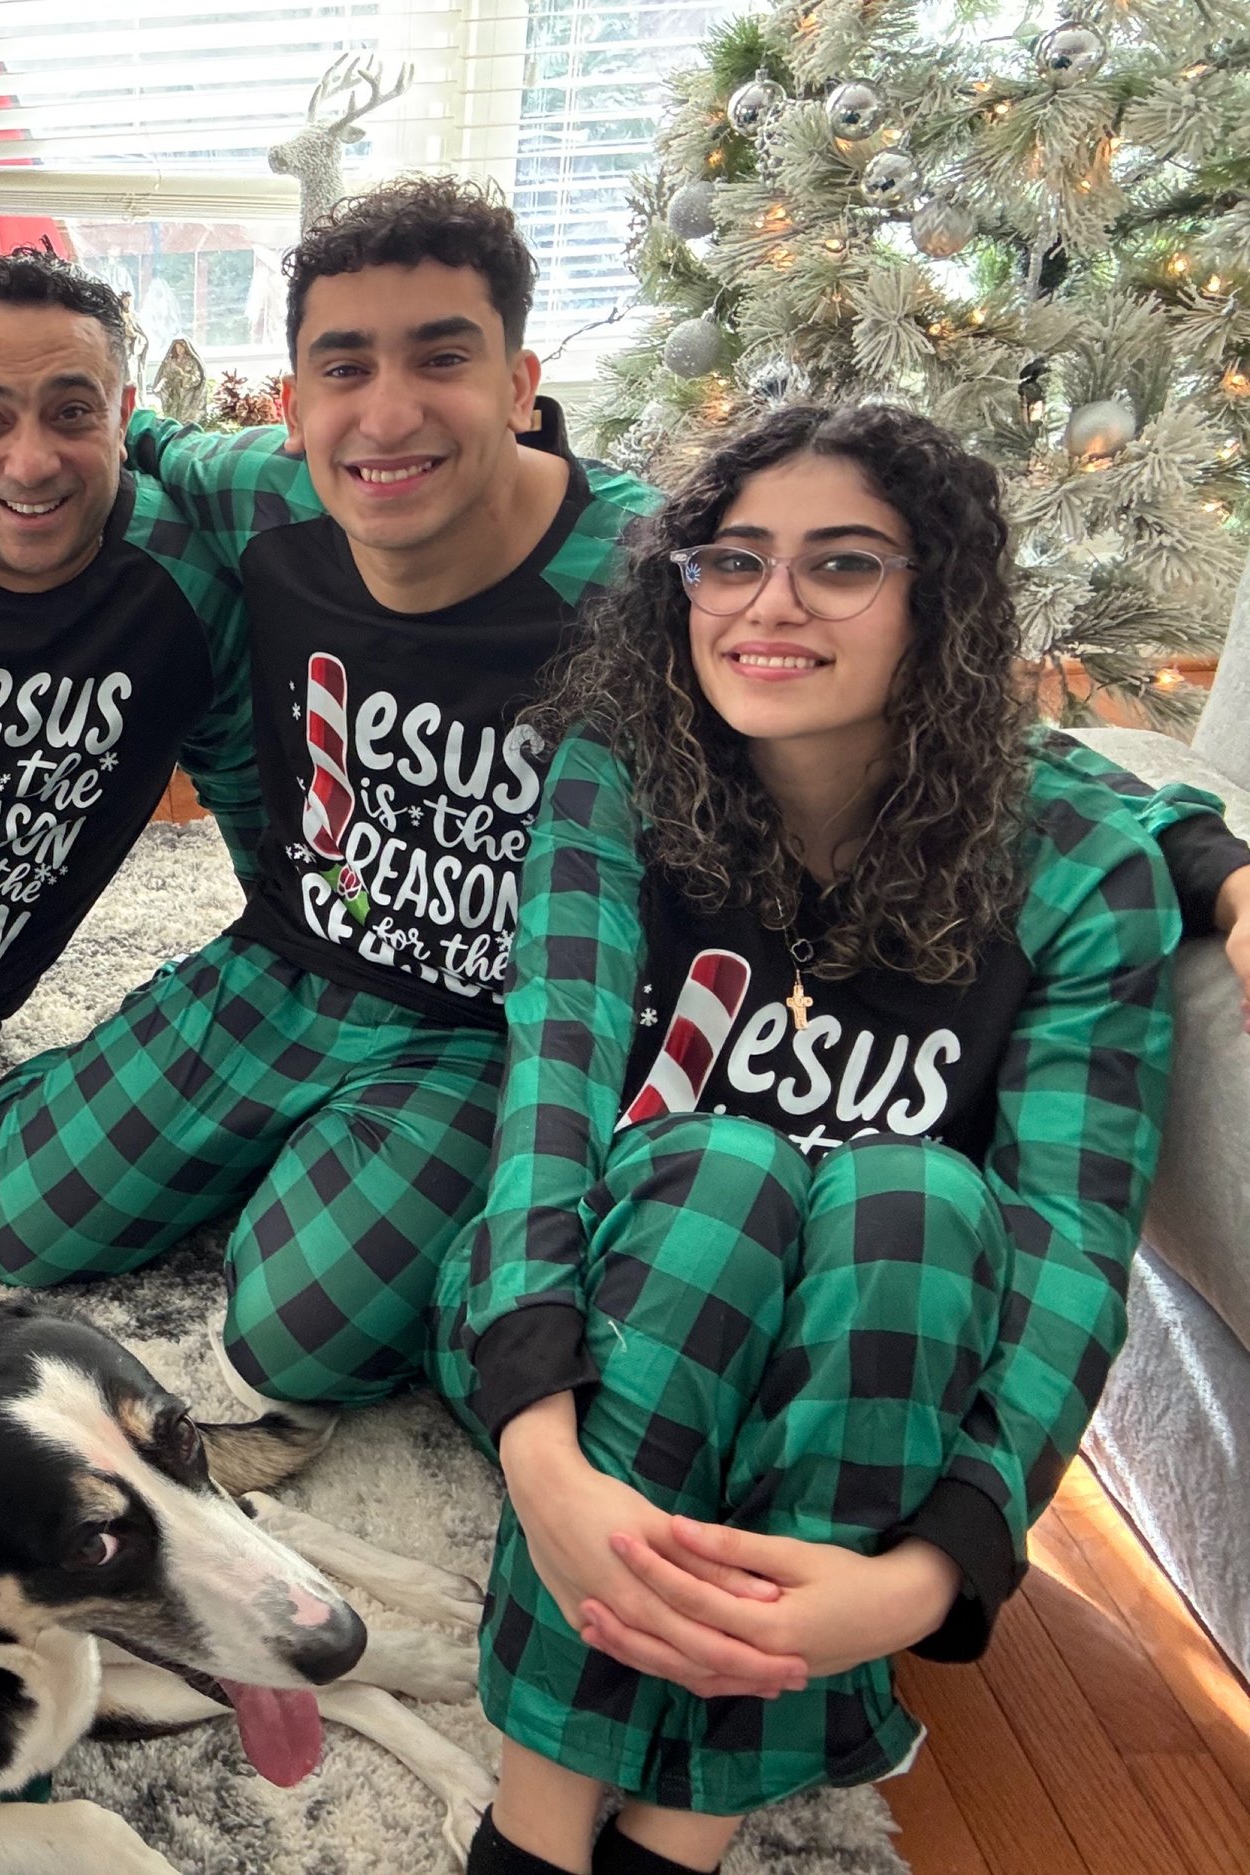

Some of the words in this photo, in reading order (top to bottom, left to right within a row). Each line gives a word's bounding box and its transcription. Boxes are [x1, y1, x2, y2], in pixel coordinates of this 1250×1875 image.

[16, 749, 103, 811] the
[302, 651, 546, 861] Jesus
[361, 777, 409, 832] is
[423, 795, 527, 862] the
[345, 821, 519, 932] REASON
[372, 916, 431, 960] for
[440, 933, 510, 981] the
